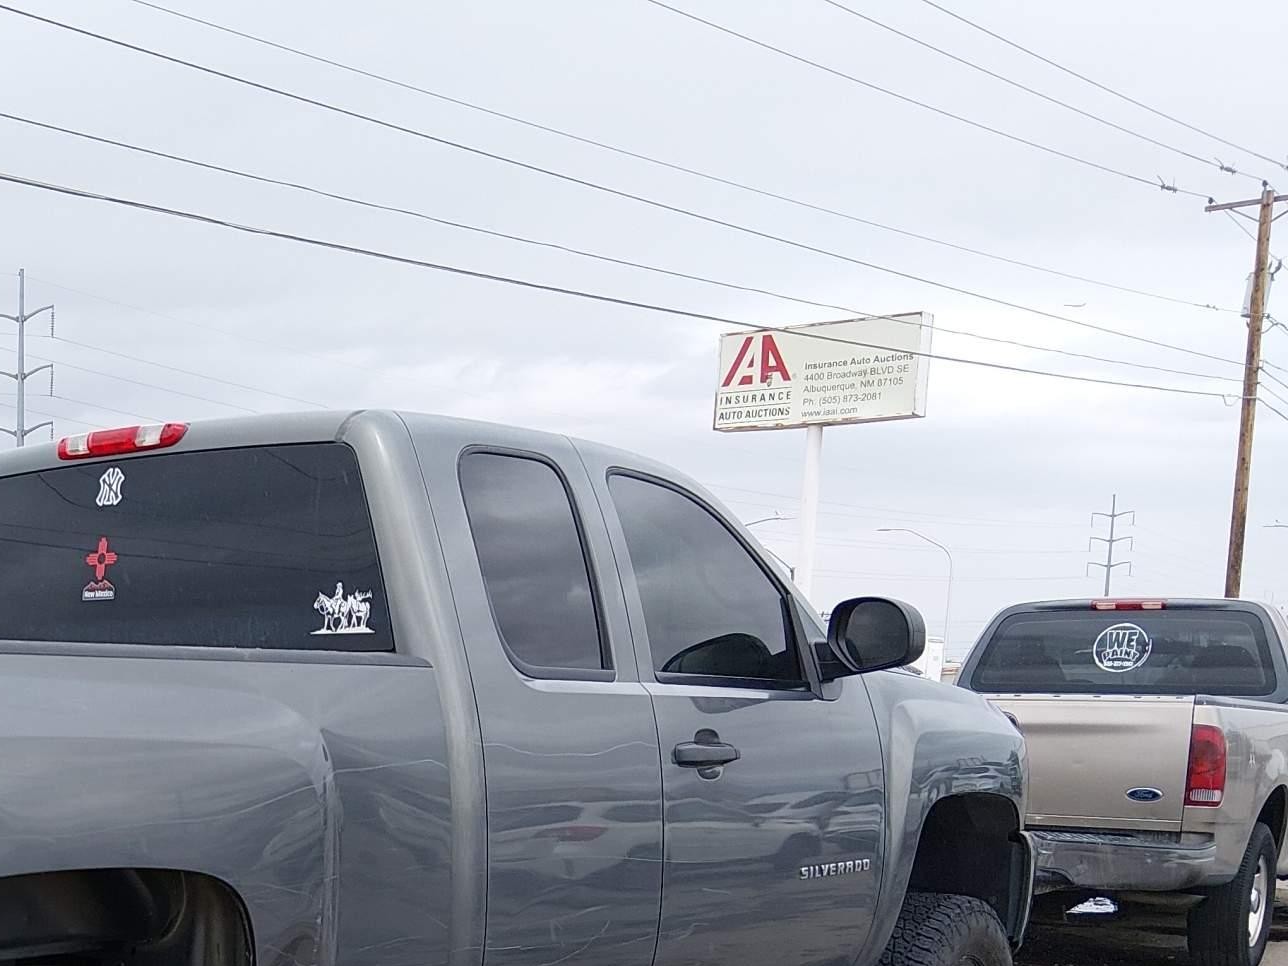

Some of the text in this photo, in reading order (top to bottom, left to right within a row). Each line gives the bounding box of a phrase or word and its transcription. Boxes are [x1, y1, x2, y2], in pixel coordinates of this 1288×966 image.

[805, 352, 914, 370] Insurance Auto Auctions
[804, 364, 910, 382] 4400 Broadway BLVD SE
[860, 380, 875, 389] NM
[877, 376, 904, 387] 87105
[719, 391, 792, 405] INSURANCE
[818, 396, 841, 406] (505)
[718, 406, 791, 421] AUTO AUCTIONS
[1107, 630, 1139, 650] WE
[1102, 649, 1139, 662] PAINT
[799, 859, 871, 880] SILVERADO
